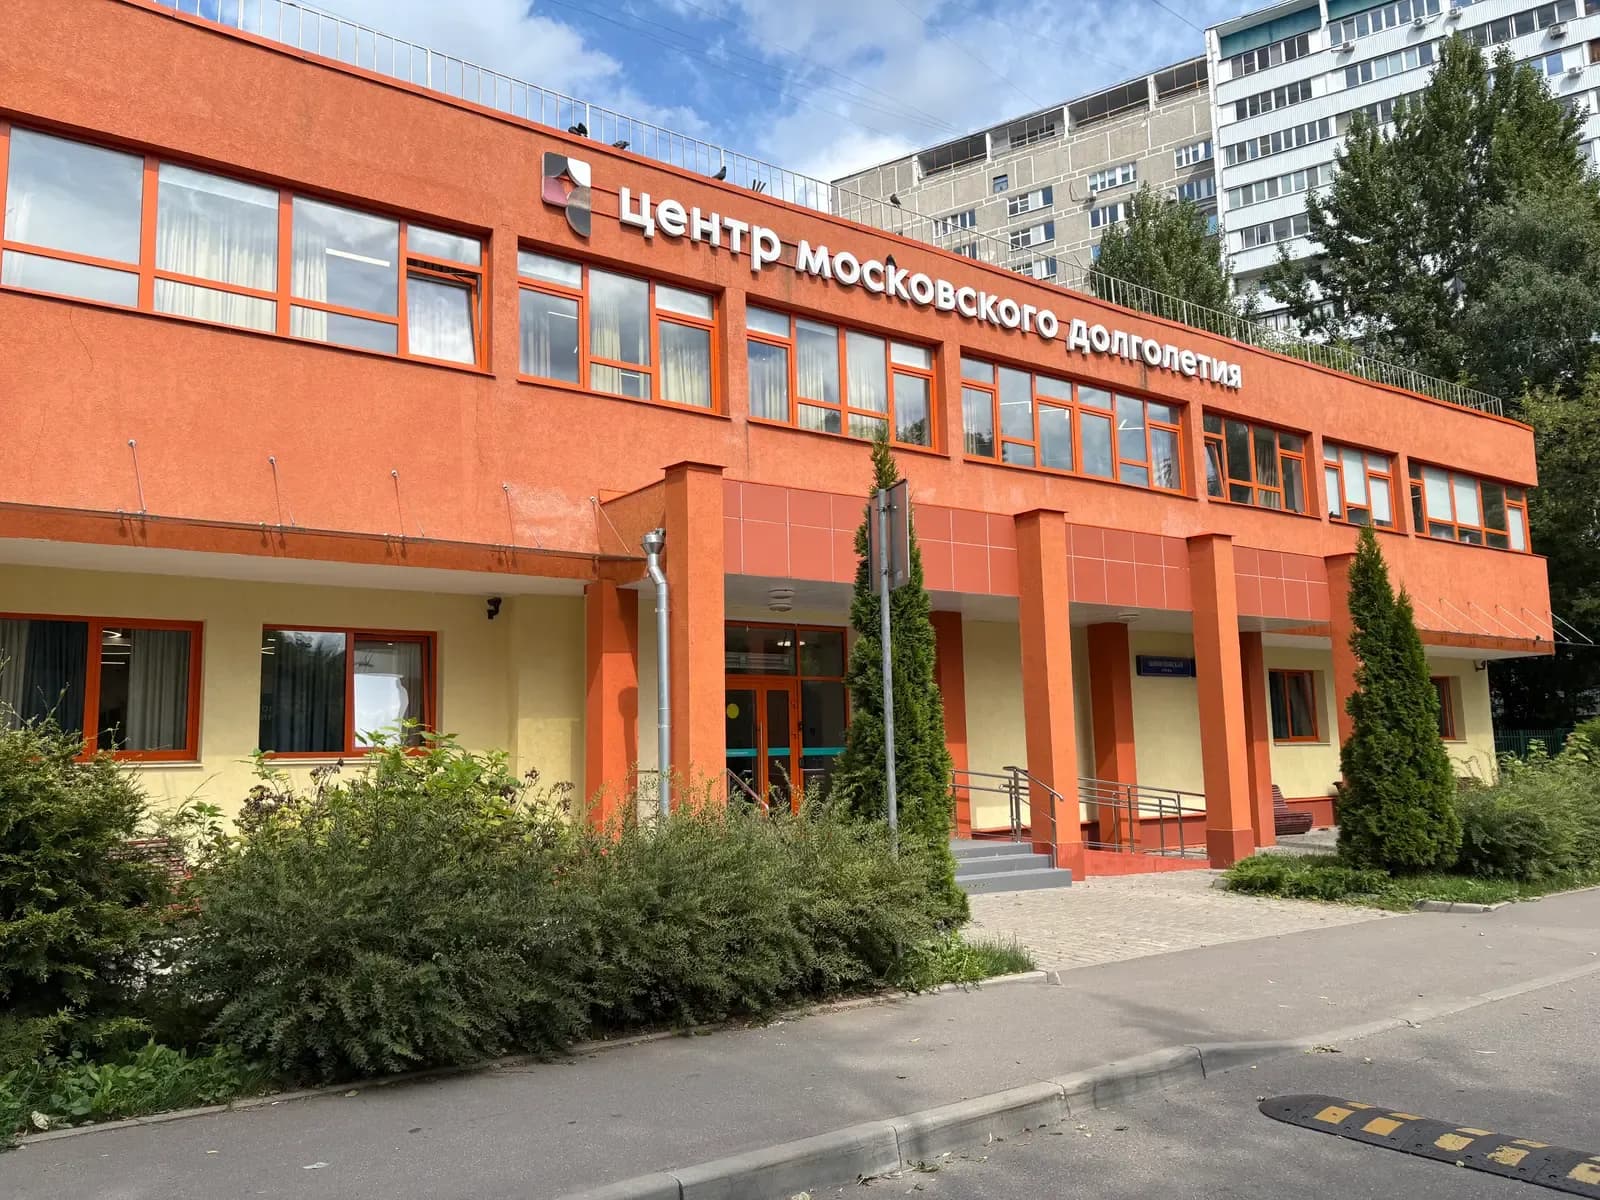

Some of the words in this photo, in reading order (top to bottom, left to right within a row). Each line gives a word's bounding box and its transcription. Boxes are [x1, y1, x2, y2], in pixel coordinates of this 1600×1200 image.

[619, 186, 782, 273] центр
[795, 239, 1059, 339] московского
[1067, 318, 1242, 389] долголетия
